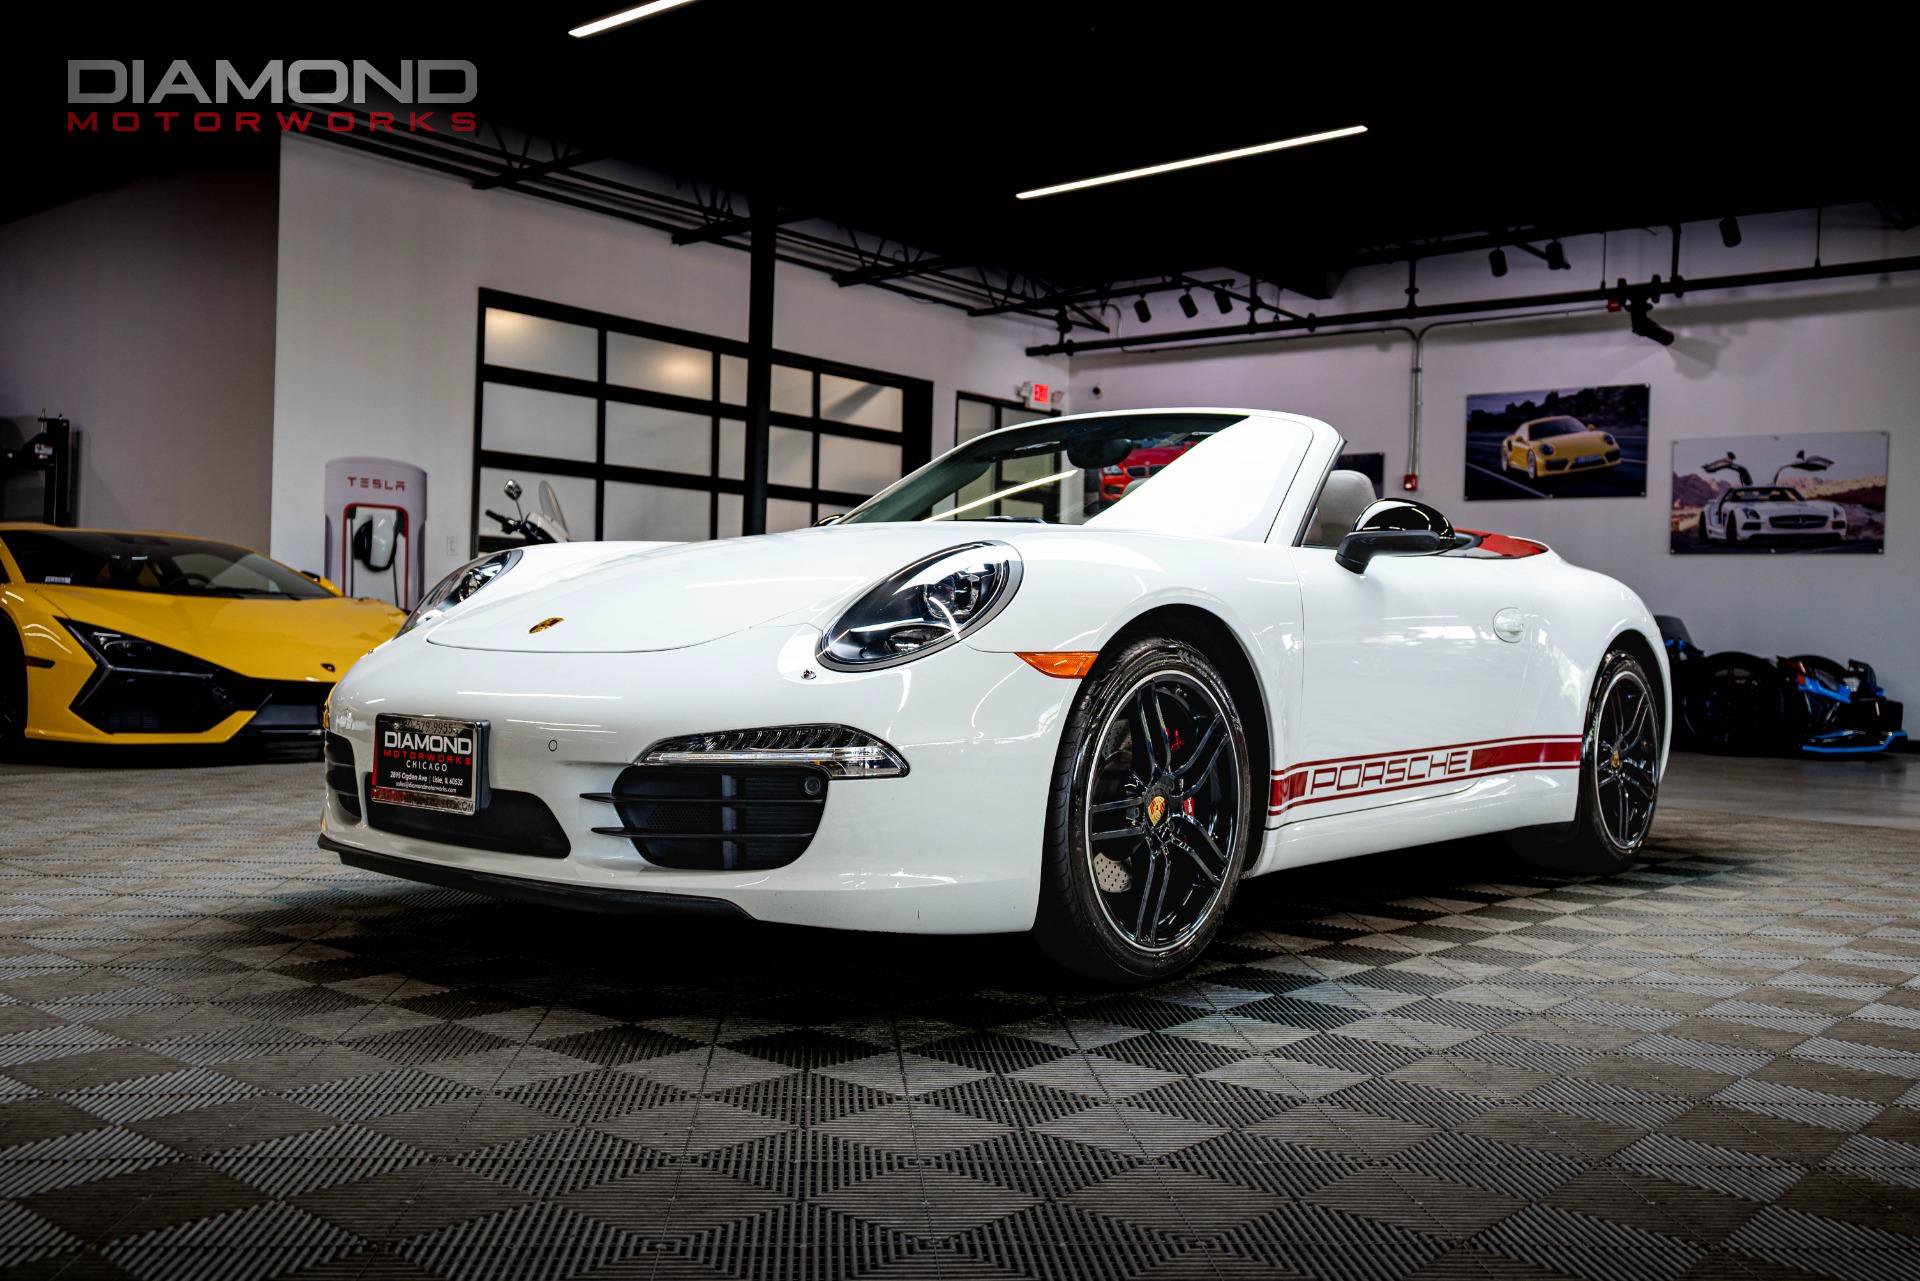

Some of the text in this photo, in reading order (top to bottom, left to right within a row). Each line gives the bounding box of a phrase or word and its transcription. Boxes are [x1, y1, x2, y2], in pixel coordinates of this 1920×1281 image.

[347, 476, 405, 492] TESLA
[384, 731, 472, 755] DIAMOND
[383, 749, 472, 766] MOTORWORKS
[405, 759, 448, 772] CHICAGO
[401, 772, 418, 781] Ogden
[1310, 750, 1468, 796] PORSCHE
